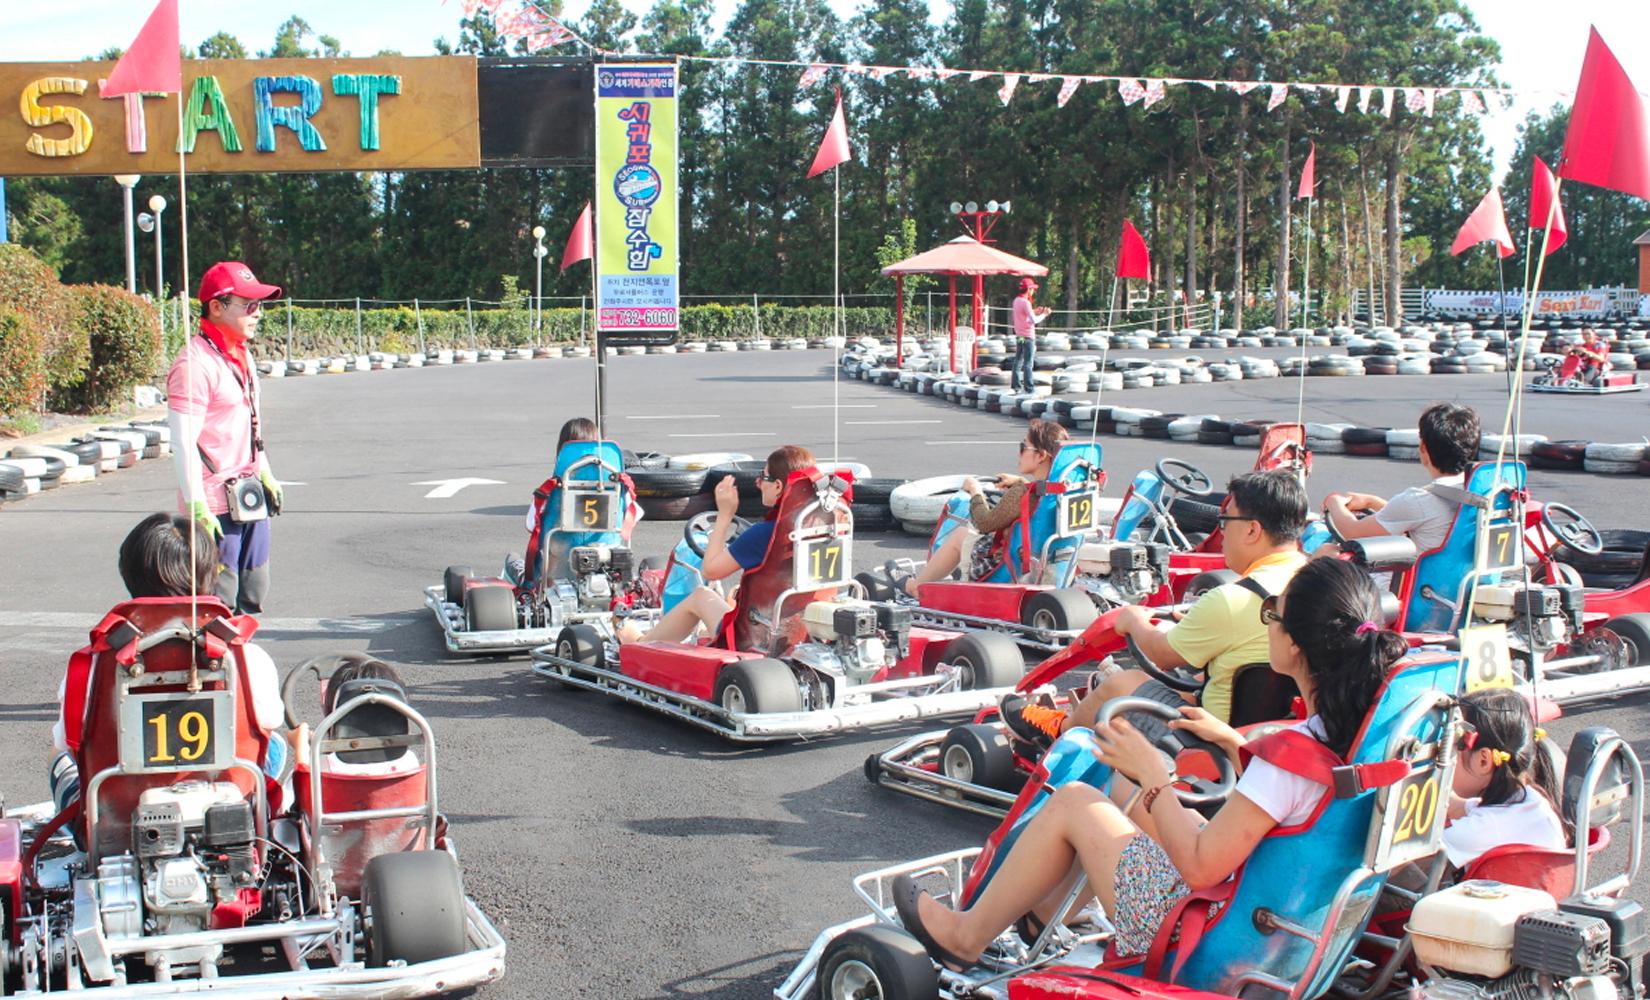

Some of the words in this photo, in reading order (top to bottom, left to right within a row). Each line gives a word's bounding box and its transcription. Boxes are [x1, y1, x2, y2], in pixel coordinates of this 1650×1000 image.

[20, 74, 402, 157] START
[620, 310, 675, 325] 732-6060
[584, 499, 598, 526] 5
[1070, 499, 1091, 528] 12
[811, 546, 840, 580] 17
[1497, 532, 1510, 563] 7
[1479, 641, 1497, 682] 8
[148, 711, 209, 762] 19
[1392, 776, 1439, 845] 20
